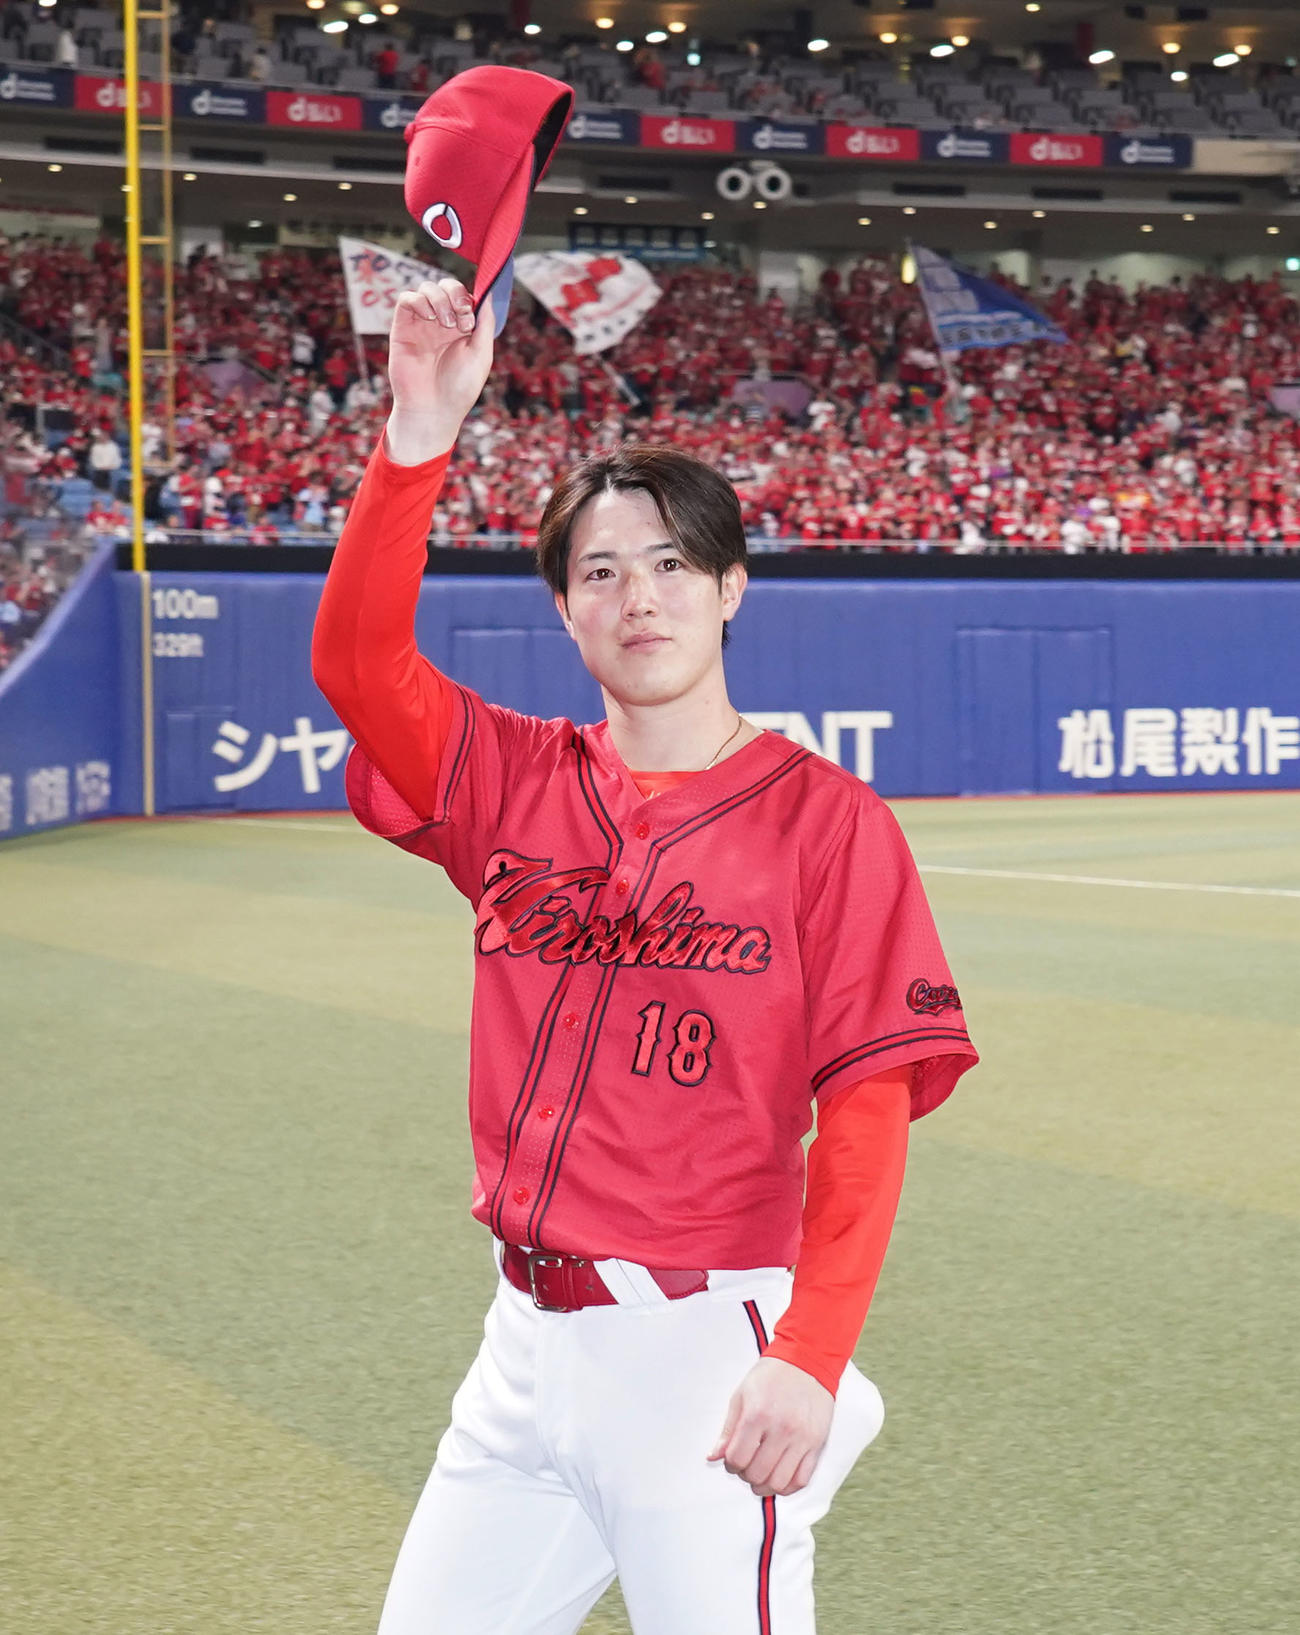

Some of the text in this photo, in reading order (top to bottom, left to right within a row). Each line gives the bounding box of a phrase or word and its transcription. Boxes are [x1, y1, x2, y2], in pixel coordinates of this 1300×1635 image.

[152, 588, 218, 619] 100m
[740, 710, 893, 783] NT
[475, 849, 772, 975] Hiroshima
[632, 1000, 716, 1087] 18
